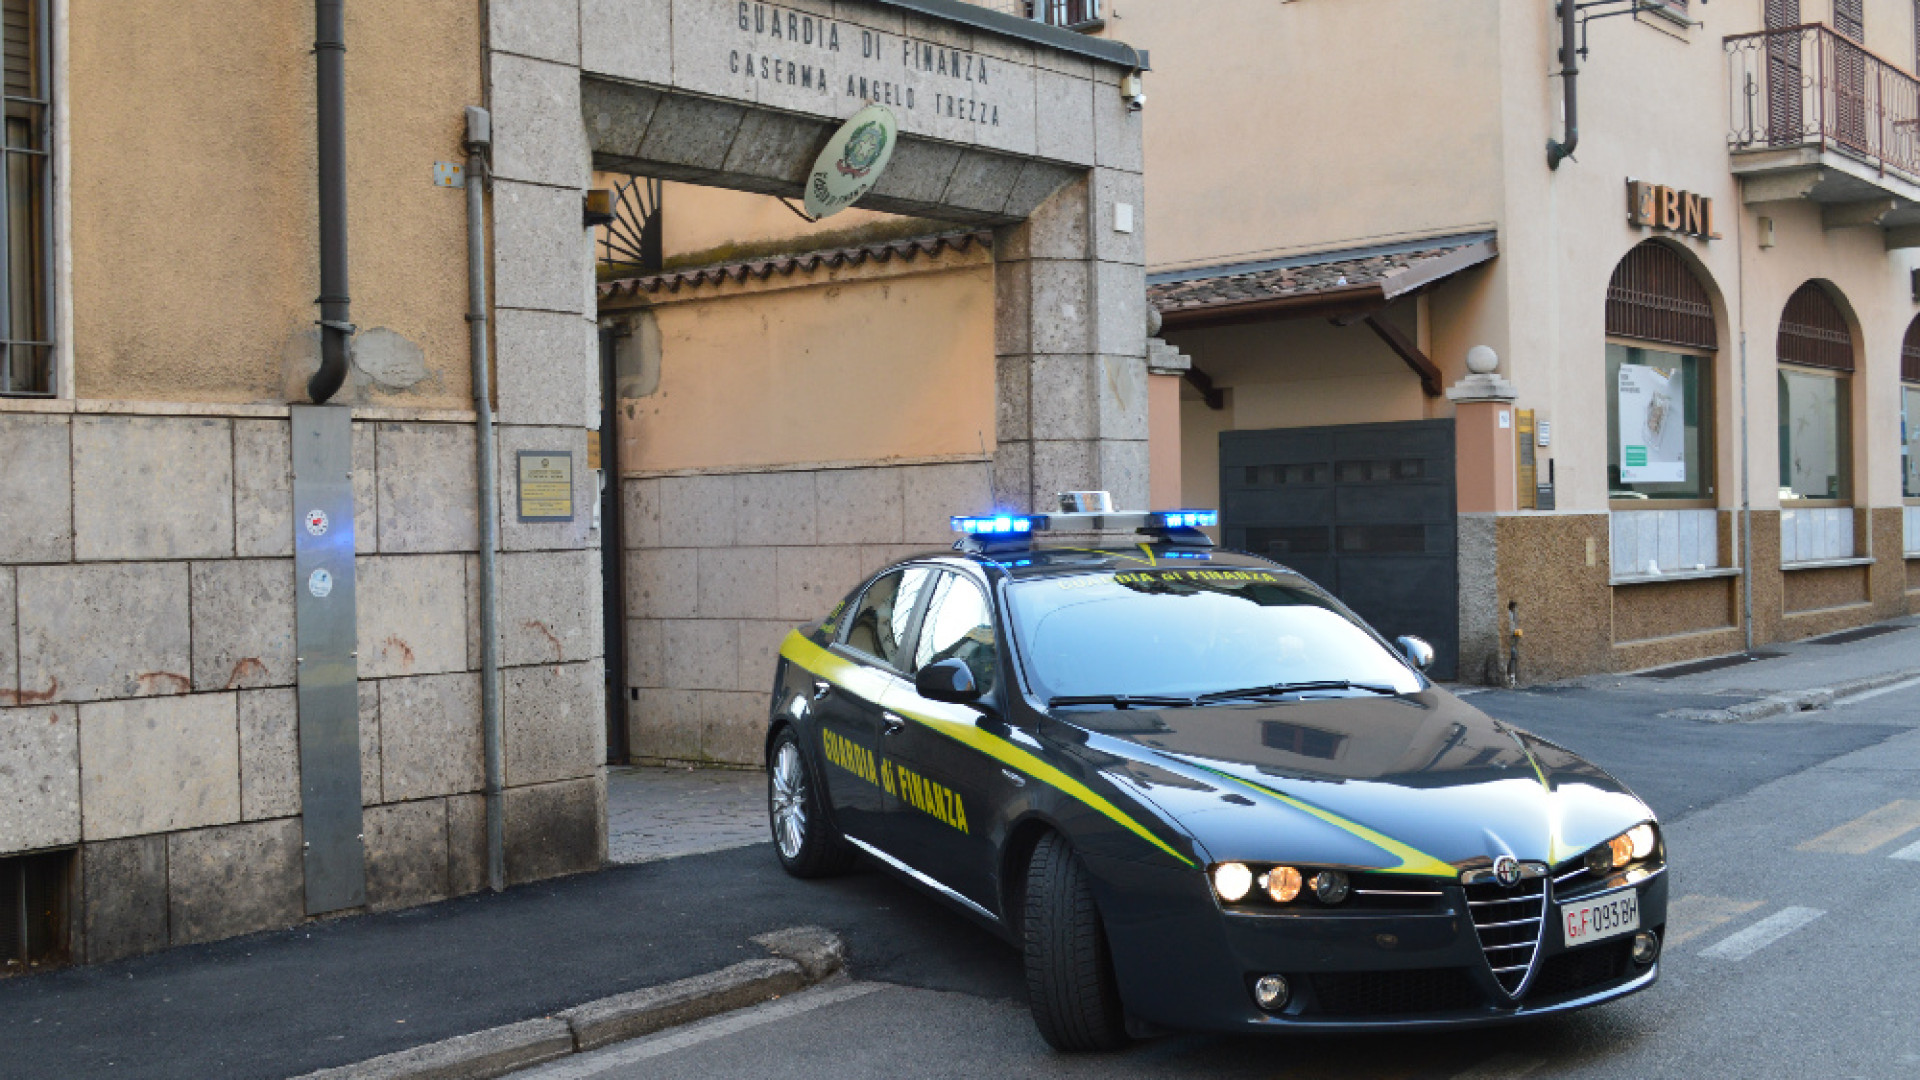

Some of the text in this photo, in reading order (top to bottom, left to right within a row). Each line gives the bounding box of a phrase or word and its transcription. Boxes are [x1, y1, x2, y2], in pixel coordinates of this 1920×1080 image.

[738, 1, 988, 85] GUARDIA DI FINANZA
[730, 49, 999, 127] CASERMA ANGELO TREZZA
[1657, 185, 1722, 240] BNL
[1187, 570, 1278, 583] FINANZA
[823, 728, 969, 834] GUARDIA di FINANZA
